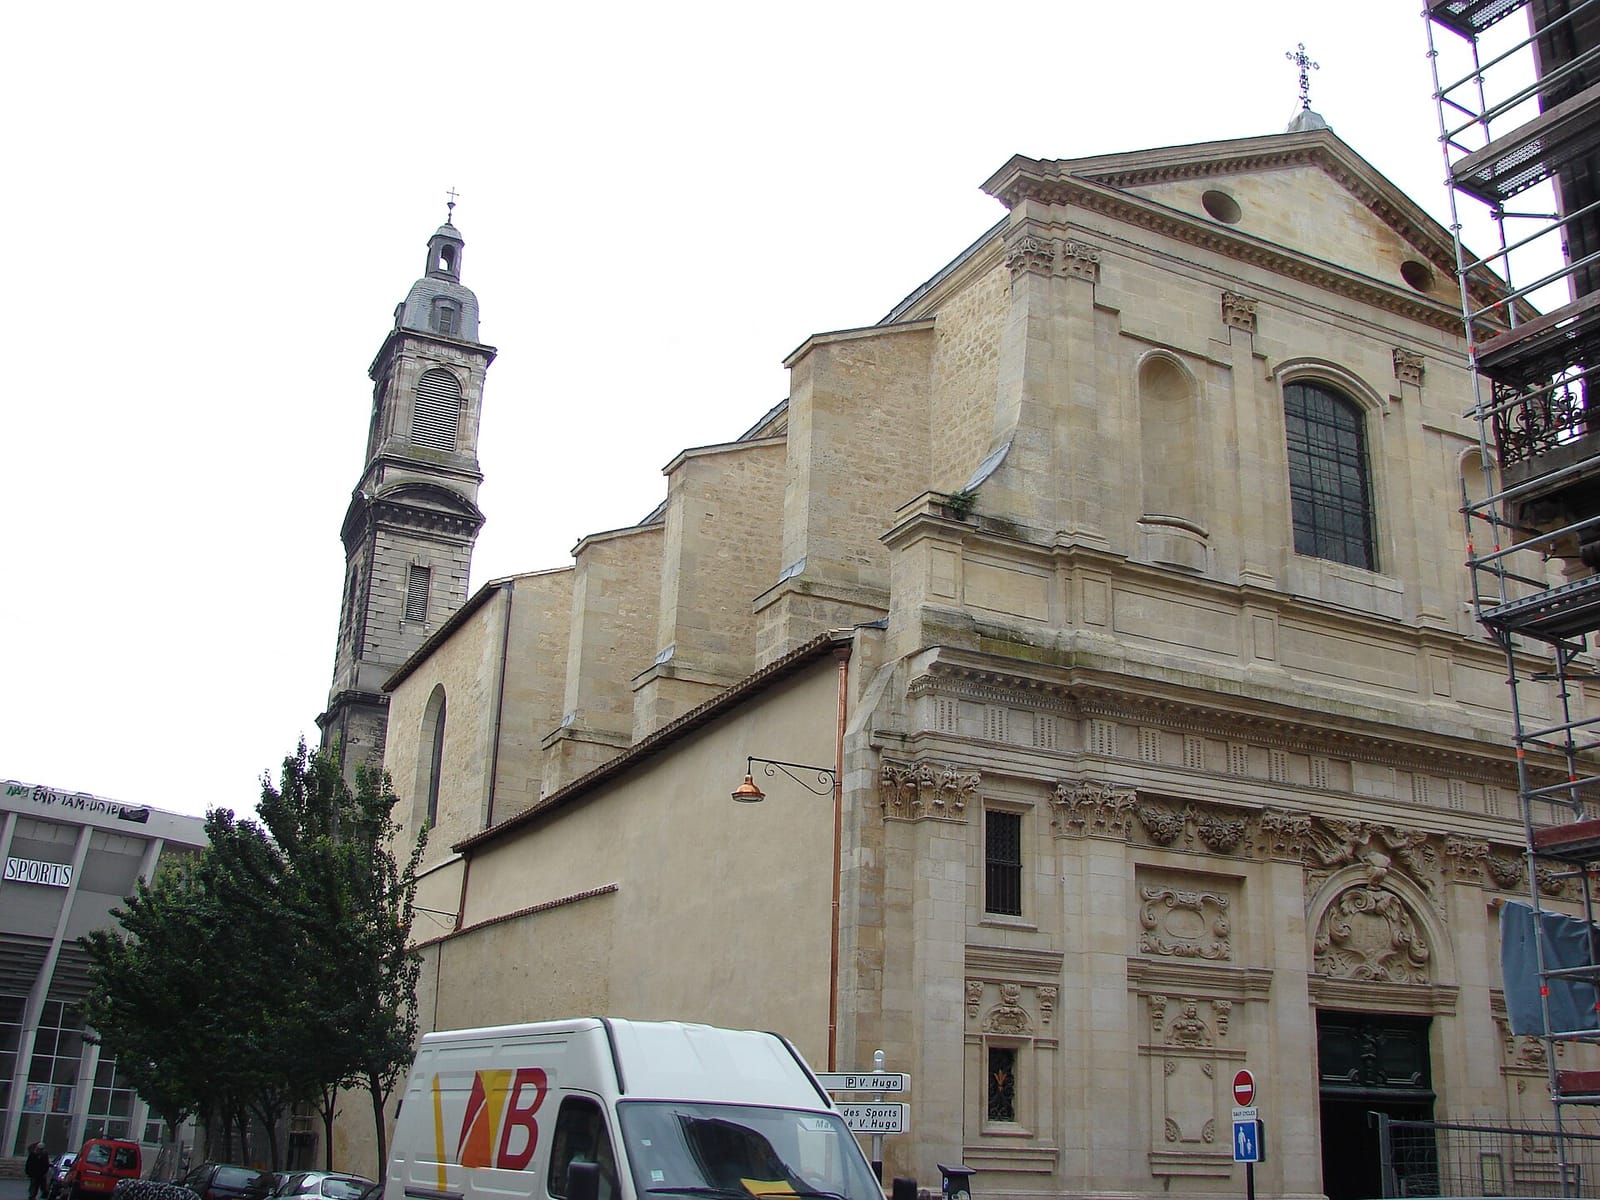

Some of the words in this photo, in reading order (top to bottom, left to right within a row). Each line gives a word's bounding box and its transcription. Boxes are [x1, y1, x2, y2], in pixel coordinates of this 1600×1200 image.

[6, 858, 72, 885] SPORTS
[859, 1078, 869, 1087] V.
[872, 1078, 898, 1089] Hugo
[843, 1107, 859, 1117] des
[865, 1107, 897, 1119] Sports
[859, 1119, 869, 1128] V.
[871, 1118, 897, 1129] Hugo
